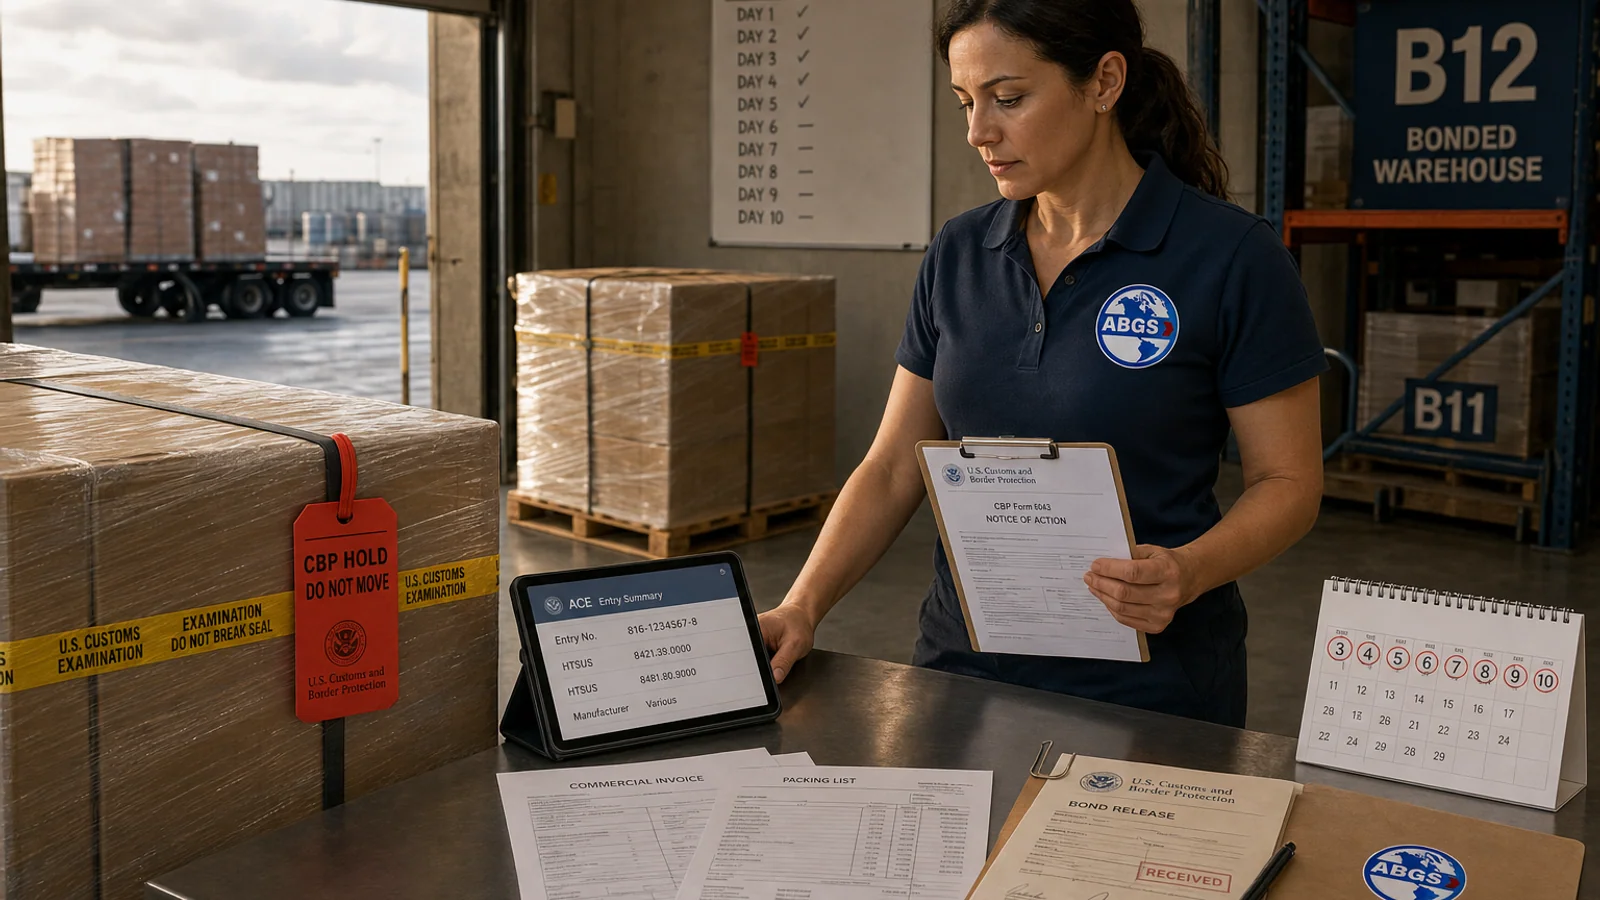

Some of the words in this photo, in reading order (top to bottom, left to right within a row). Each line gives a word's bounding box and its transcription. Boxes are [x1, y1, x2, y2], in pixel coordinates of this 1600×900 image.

[737, 8, 763, 21] DAY
[769, 7, 774, 21] 1
[737, 30, 763, 44] DAY
[769, 30, 777, 44] 2
[737, 52, 763, 66] DAY
[769, 52, 776, 66] 3
[1395, 22, 1538, 105] B12
[738, 75, 763, 89] DAY
[769, 75, 777, 89] 4
[738, 98, 763, 112] DAY
[769, 97, 777, 111] 5
[738, 120, 763, 134] DAY
[769, 120, 778, 134] 6
[1407, 125, 1517, 151] BONDED
[738, 143, 763, 156] DAY
[769, 142, 777, 156] 7
[738, 165, 763, 179] DAY
[769, 165, 777, 179] 8
[1373, 156, 1543, 184] WAREHOUSE
[738, 188, 763, 201] DAY
[769, 187, 778, 201] 9
[738, 210, 763, 224] DAY
[771, 210, 784, 224] 10
[1102, 316, 1159, 334] ABGS
[1415, 387, 1485, 435] B11
[967, 467, 983, 475] U.S.
[984, 467, 1016, 475] Customs
[970, 476, 995, 484] Border
[997, 476, 1036, 484] Protection
[986, 515, 1018, 523] NOTICE
[1035, 516, 1067, 525] ACTION
[304, 553, 338, 574] CBP
[344, 547, 388, 569] HOLD
[306, 581, 324, 600] DO
[329, 578, 353, 598] NOT
[357, 573, 389, 594] MOVE
[405, 575, 422, 588] U.S.
[423, 567, 465, 584] CUSTOMS
[406, 582, 466, 605] EXAMINATION
[569, 597, 593, 610] ACE
[599, 595, 622, 608] Entry
[623, 591, 663, 603] Summary
[183, 604, 262, 631] EXAMINATION
[60, 638, 82, 654] U.S.
[85, 626, 140, 649] CUSTOMS
[172, 636, 186, 652] DO
[190, 632, 210, 649] NOT
[214, 624, 246, 643] BREAK
[249, 619, 273, 636] SEAL
[555, 634, 580, 645] Entry
[581, 632, 597, 642] No.
[628, 617, 698, 635] 816-1234567-8
[58, 644, 143, 674] EXAMINATION
[562, 659, 593, 671] HTSUS
[1336, 643, 1344, 655] 3
[1363, 648, 1373, 660] 4
[1393, 652, 1403, 665] 5
[1422, 657, 1431, 670] 6
[1452, 660, 1461, 674] 7
[1480, 665, 1490, 679] 8
[1510, 670, 1520, 683] 9
[1538, 674, 1554, 688] 10
[308, 676, 327, 687] U.S.
[330, 671, 366, 684] Customs
[368, 667, 385, 678] and
[568, 684, 598, 697] HTSUS
[640, 668, 696, 684] 8481.80.9000
[308, 687, 339, 700] Border
[342, 680, 386, 696] Protection
[1329, 681, 1338, 691] 11
[1357, 686, 1367, 696] 12
[1385, 690, 1395, 700] 13
[1414, 694, 1424, 704] 14
[1443, 699, 1454, 709] 15
[1473, 704, 1484, 714] 16
[1504, 708, 1514, 719] 17
[573, 704, 629, 721] Manufacturer
[646, 696, 677, 708] Various
[1323, 706, 1335, 716] 28
[1379, 715, 1391, 726] 26
[1409, 720, 1419, 730] 21
[1438, 725, 1449, 736] 22
[1468, 730, 1479, 741] 23
[1498, 735, 1510, 746] 24
[1319, 731, 1330, 742] 22
[1346, 736, 1358, 747] 24
[1375, 741, 1387, 751] 29
[1404, 746, 1416, 757] 28
[1433, 751, 1445, 762] 29
[569, 778, 652, 790] COMMERCIAL
[656, 775, 704, 784] INVOICE
[1132, 778, 1155, 787] U.S.
[1159, 780, 1207, 792] Customs
[1210, 787, 1233, 796] and
[1129, 785, 1171, 797] Border
[1174, 790, 1236, 804] Protection
[1068, 801, 1108, 811] BOND
[1112, 806, 1176, 820] RELEASE
[1146, 868, 1222, 887] RECEIVED
[1370, 862, 1442, 884] ABGS
